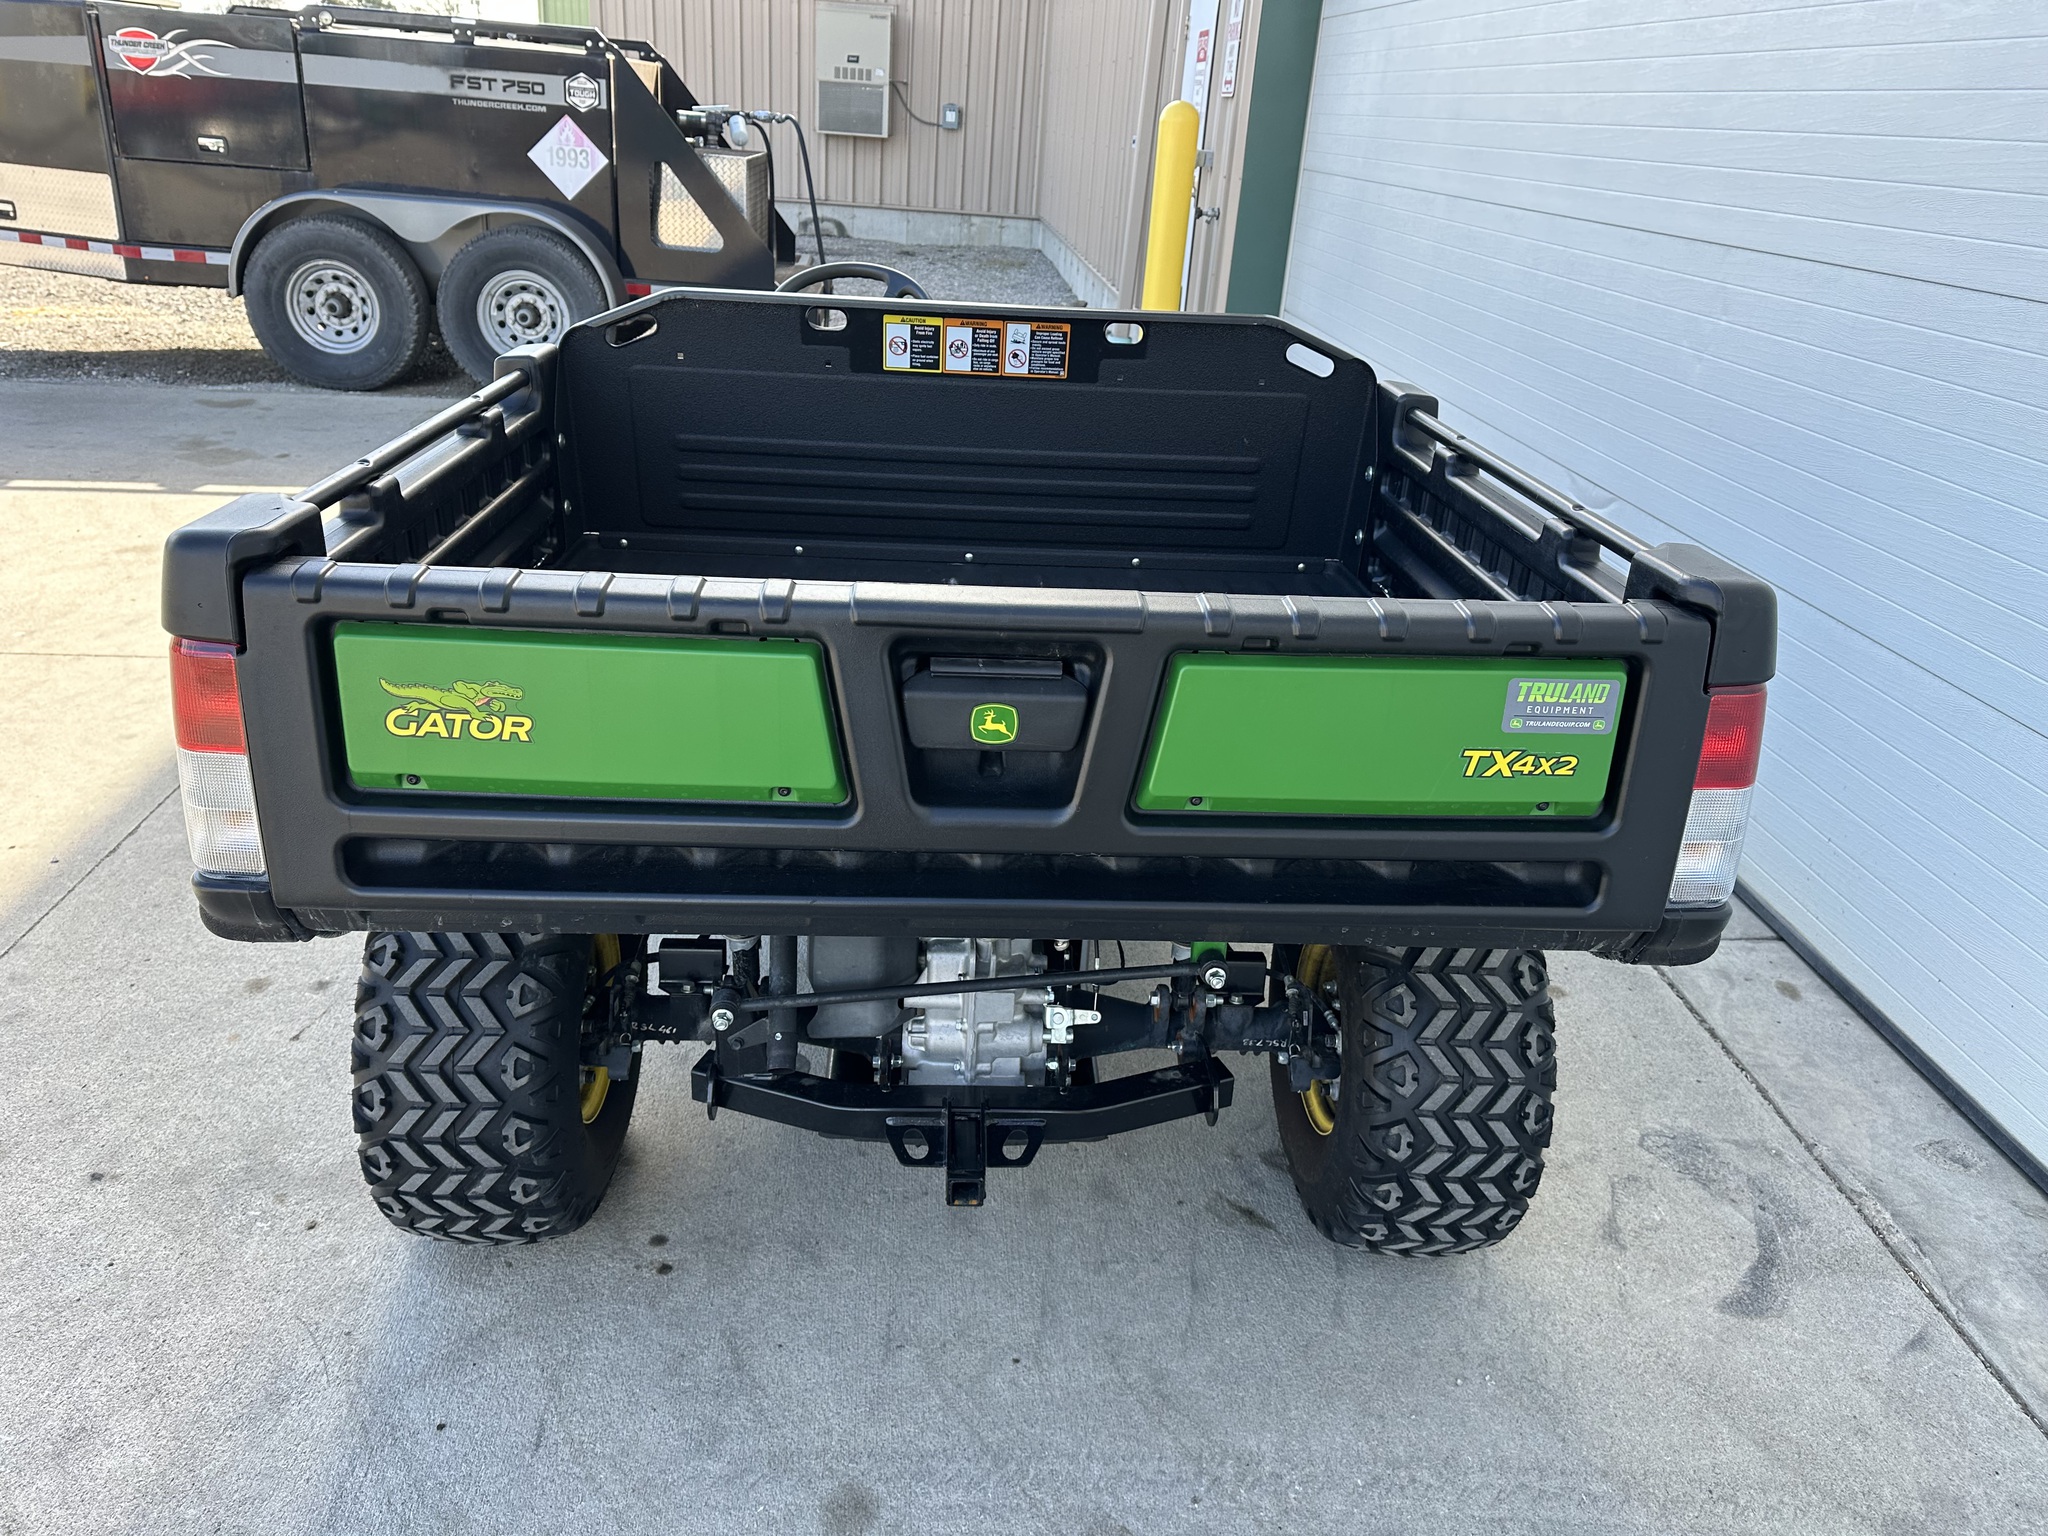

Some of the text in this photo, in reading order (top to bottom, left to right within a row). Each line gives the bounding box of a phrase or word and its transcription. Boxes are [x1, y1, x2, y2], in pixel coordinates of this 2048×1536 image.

[111, 39, 165, 49] THUNDER CREEK
[450, 75, 545, 95] FST 750
[570, 89, 596, 98] TOUGH
[452, 98, 546, 112] THUNDERCREEK.COM
[547, 146, 590, 170] 1993
[1517, 681, 1611, 704] TRULAND
[1526, 705, 1595, 715] EQUIPMENT
[385, 707, 534, 743] GATOR
[1525, 720, 1591, 728] TRULANDEQUIP.COM
